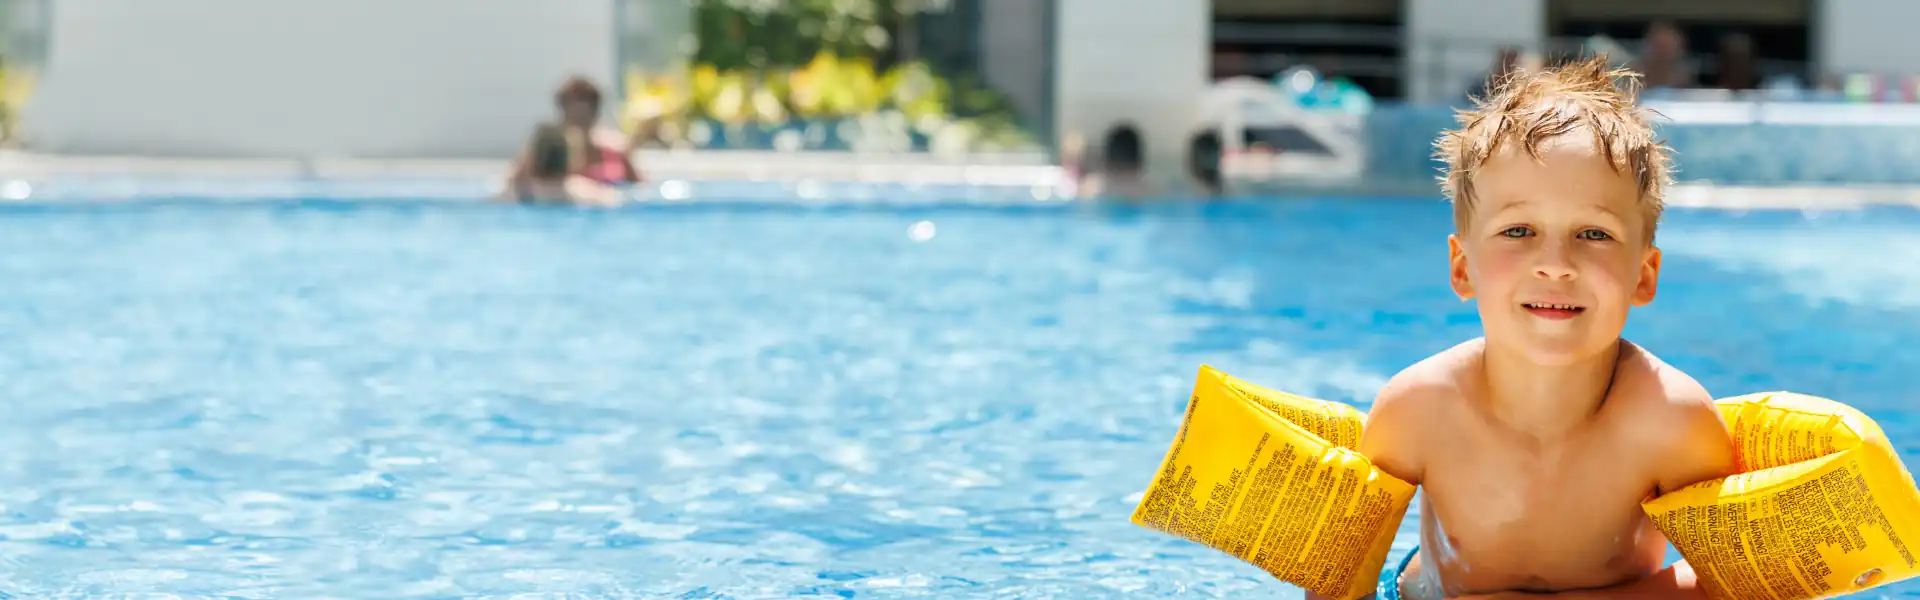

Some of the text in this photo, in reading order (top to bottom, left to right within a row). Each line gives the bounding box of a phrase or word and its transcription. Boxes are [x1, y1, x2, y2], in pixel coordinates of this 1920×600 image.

[1836, 465, 1851, 480] USE
[1210, 491, 1220, 502] NE
[1212, 481, 1225, 496] PAS
[1802, 481, 1813, 496] PAS
[1776, 489, 1791, 518] LAISSER
[1804, 493, 1823, 520] CONTRE
[1809, 478, 1837, 524] AVERTISSEMENT
[1830, 523, 1843, 534] NE
[1819, 473, 1836, 496] UNDER
[1828, 493, 1852, 524] COMPETENT
[1211, 503, 1225, 521] SANS
[1707, 502, 1720, 547] WARNUNG!
[1782, 515, 1794, 530] LES
[1803, 515, 1817, 531] QUE
[1814, 516, 1827, 528] LA
[1726, 500, 1749, 565] AVERTISSEMENT!
[1749, 517, 1769, 559] WARNING!
[1785, 487, 1807, 535] SURVEILLANCE
[1818, 565, 1833, 578] PAS
[1786, 526, 1806, 555] ENFANTS
[1808, 528, 1825, 546] SOUS
[1798, 551, 1814, 568] SANS
